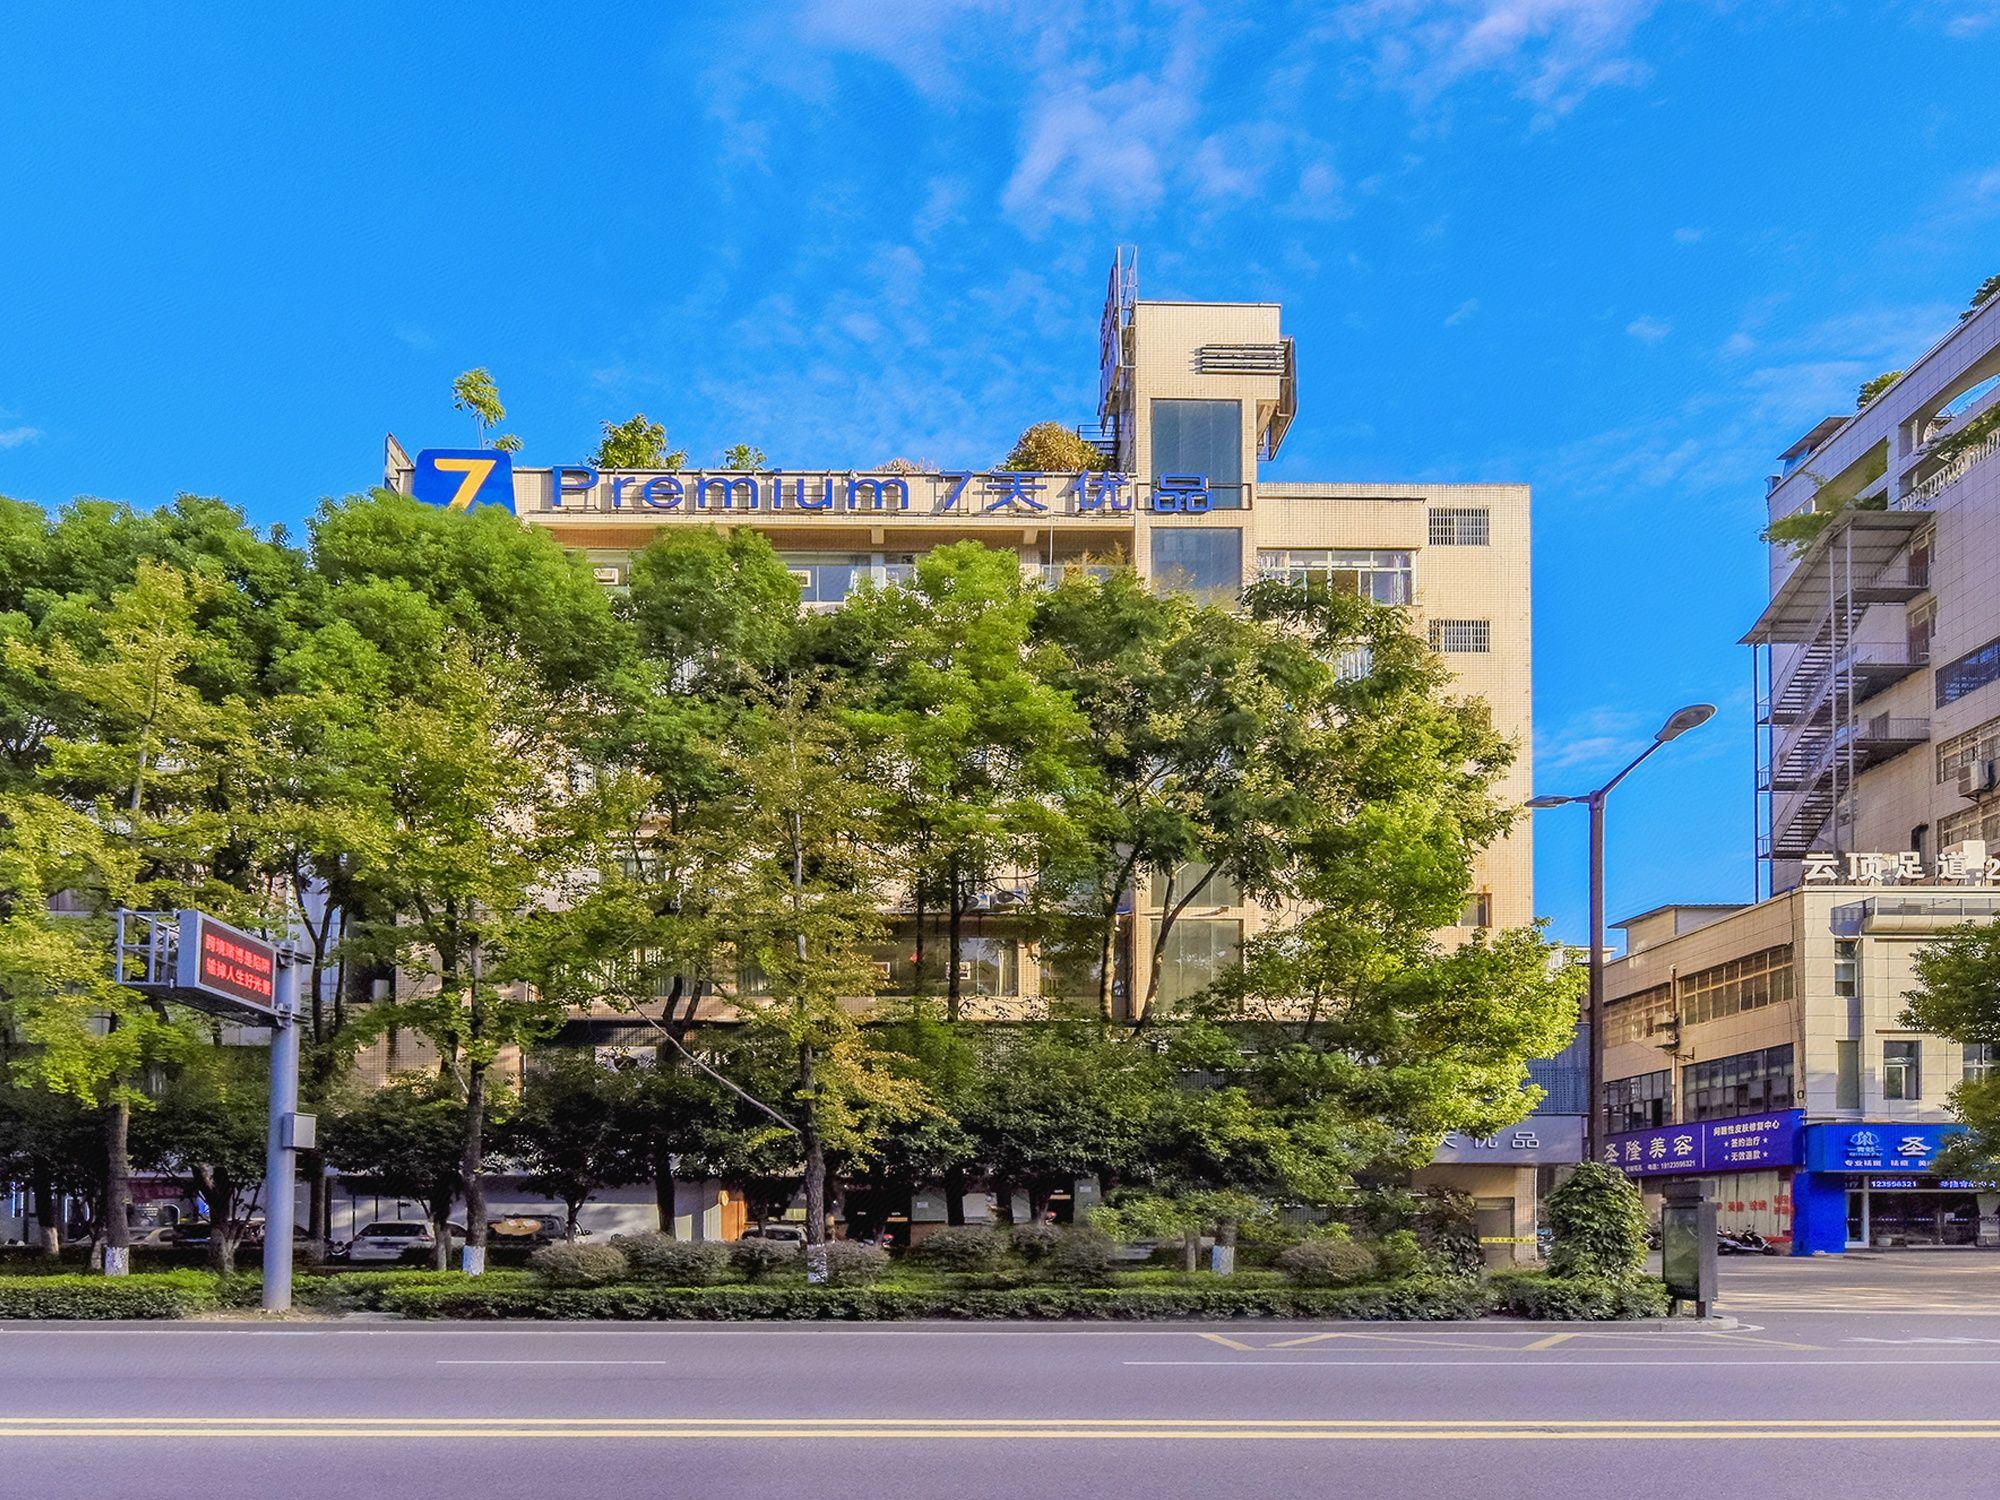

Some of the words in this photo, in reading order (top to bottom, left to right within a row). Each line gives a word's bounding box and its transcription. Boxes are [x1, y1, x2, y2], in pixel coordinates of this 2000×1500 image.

[434, 458, 497, 512] 7
[551, 465, 909, 510] Premium
[939, 468, 1213, 513] 7天优品
[1603, 1134, 1694, 1163] 圣隆美容
